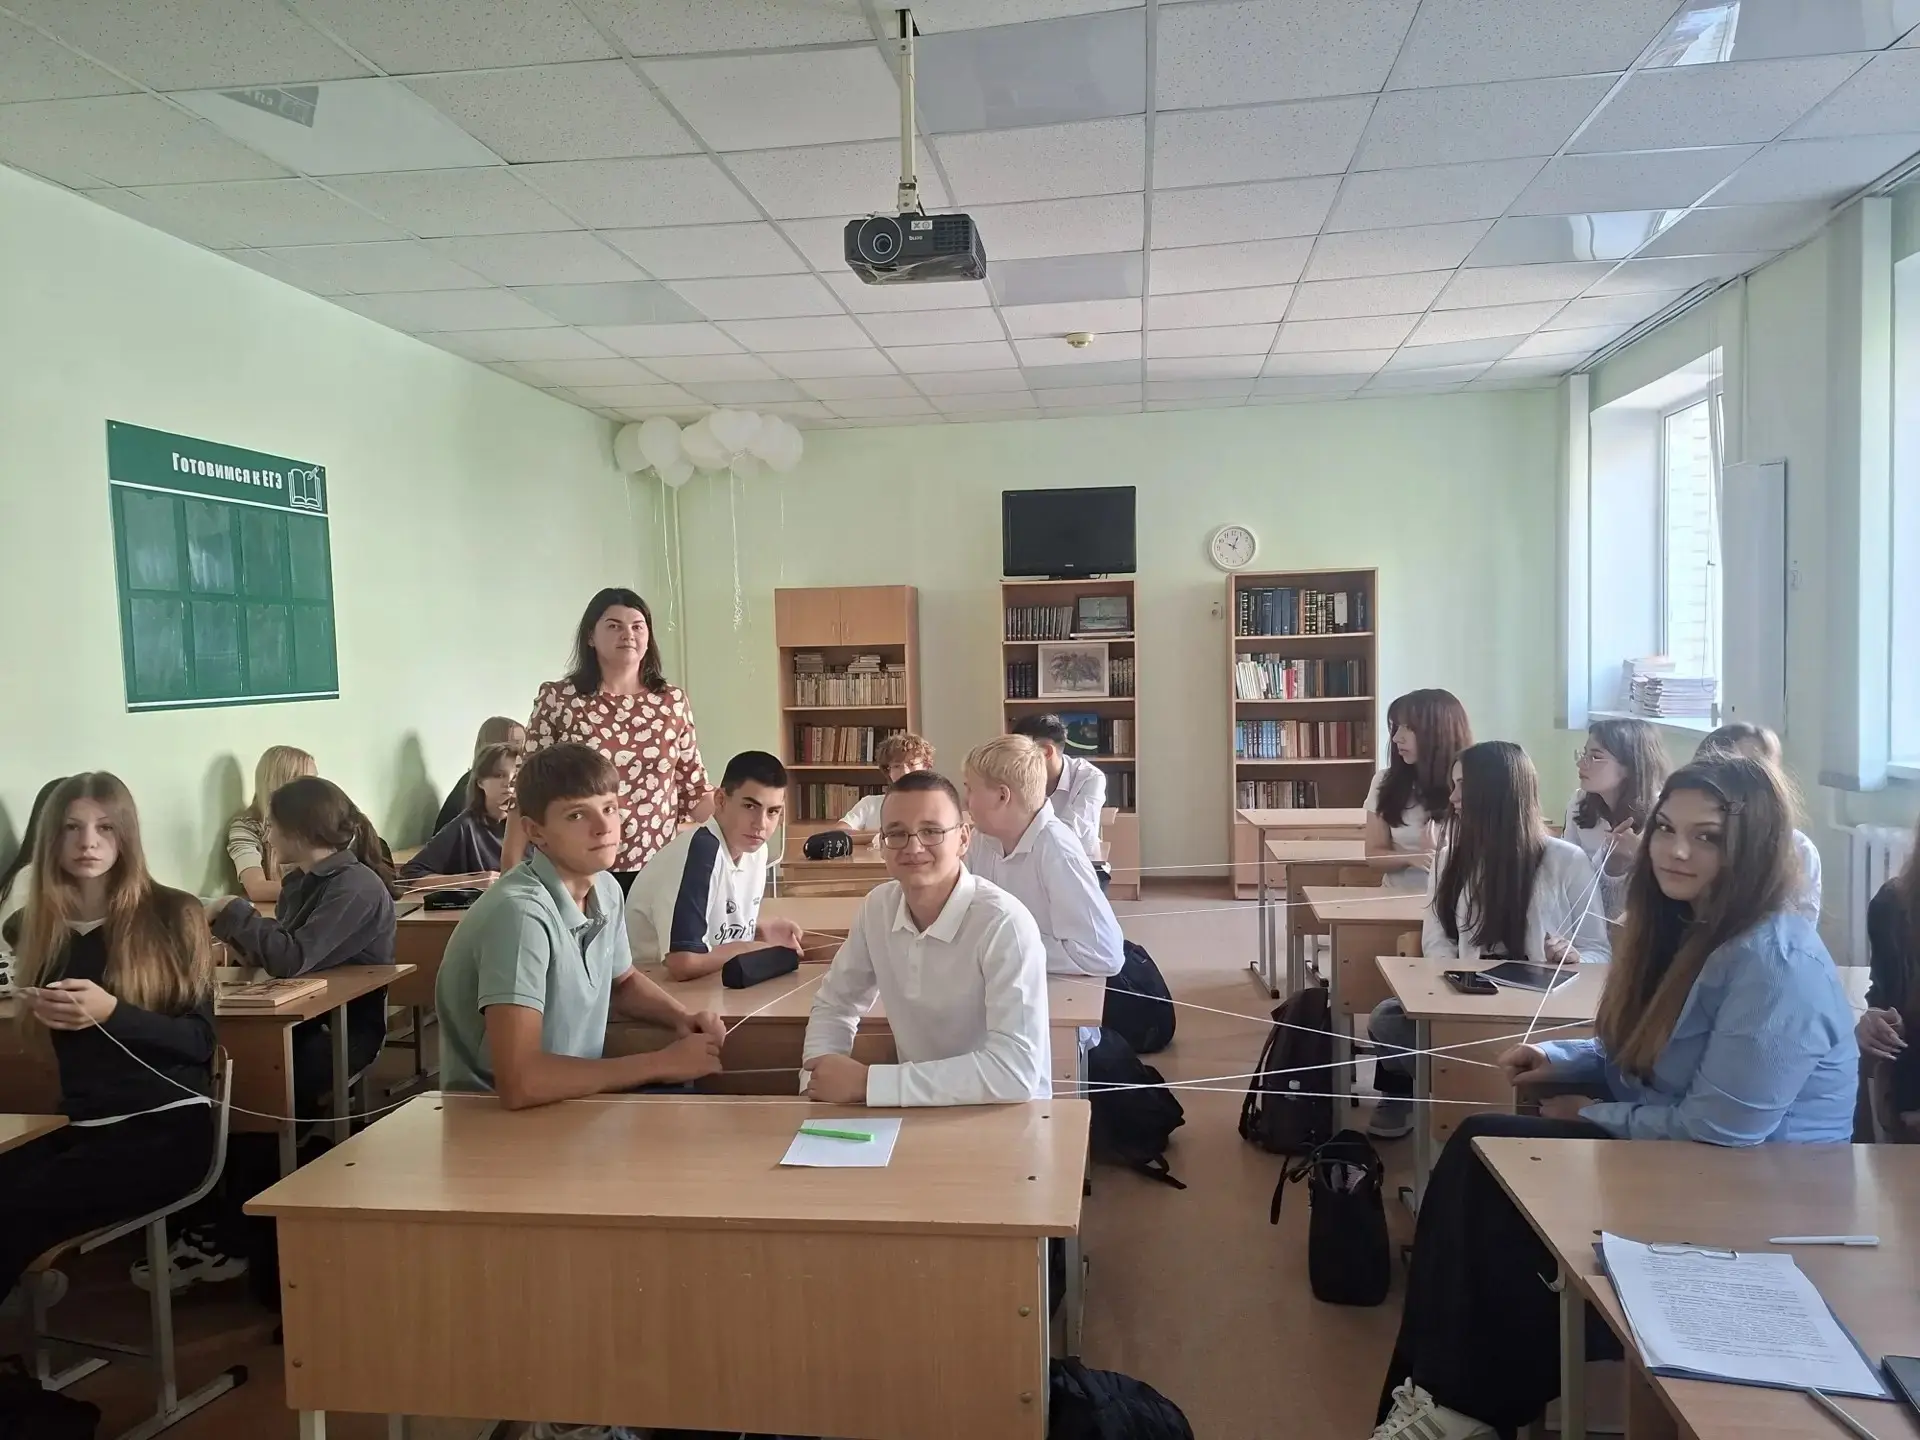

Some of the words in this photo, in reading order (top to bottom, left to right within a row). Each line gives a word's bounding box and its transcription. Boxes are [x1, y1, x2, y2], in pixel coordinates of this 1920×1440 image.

[171, 451, 250, 484] Готовимся
[252, 470, 261, 486] к
[262, 469, 283, 490] ЕГЭ
